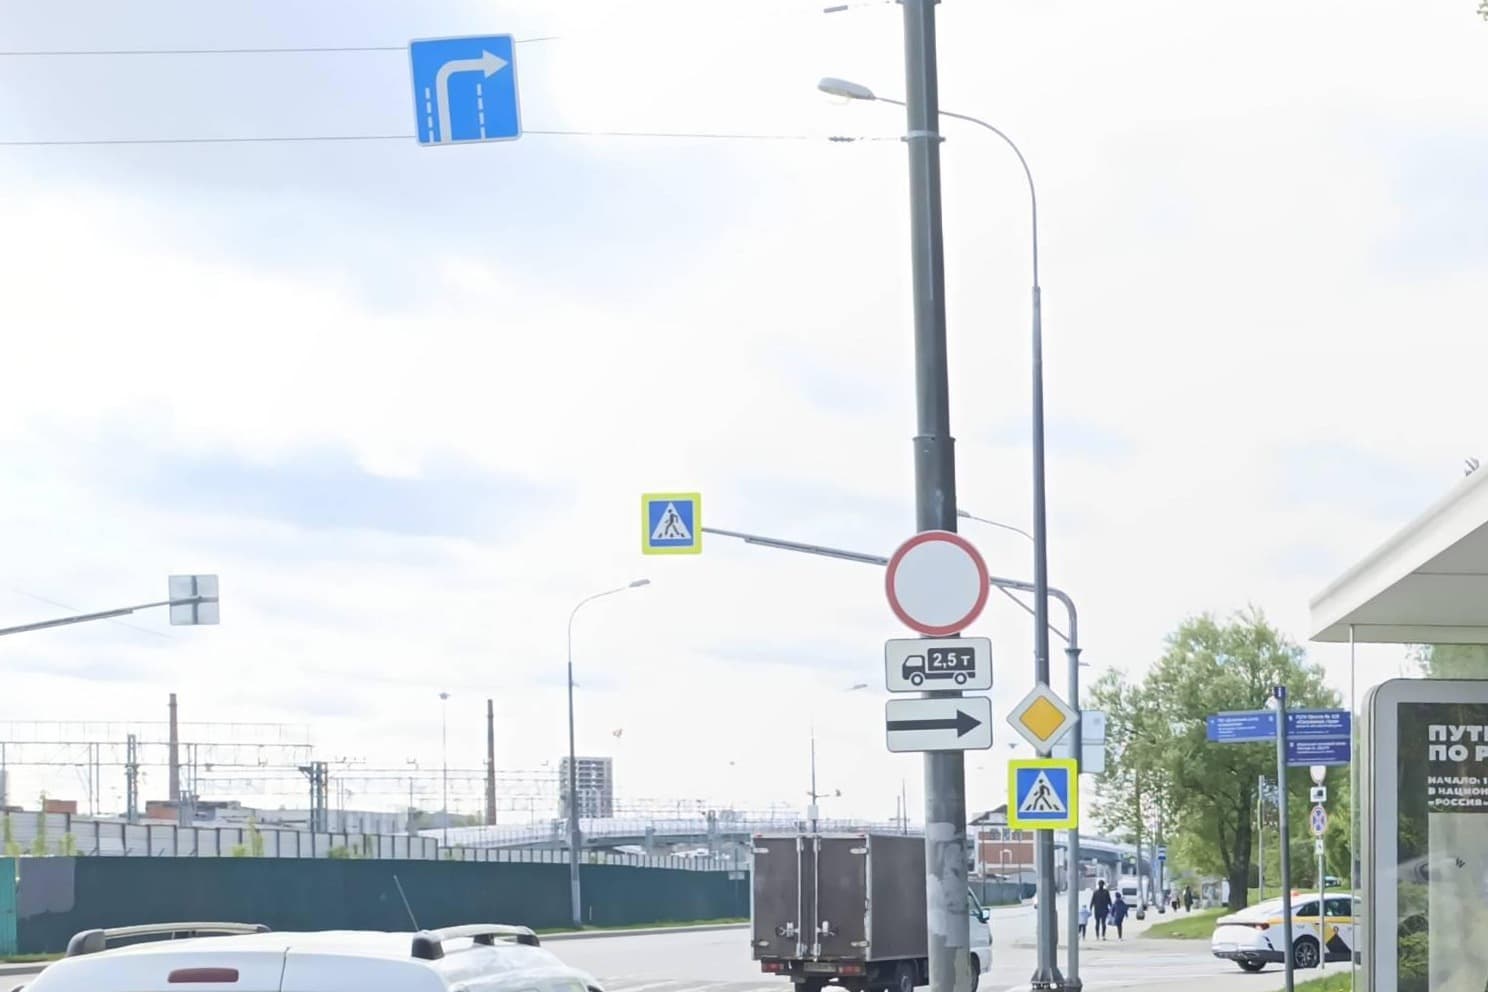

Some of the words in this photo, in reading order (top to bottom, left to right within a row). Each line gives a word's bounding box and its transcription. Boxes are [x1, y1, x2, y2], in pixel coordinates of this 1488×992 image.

[932, 652, 958, 669] 2,5
[1428, 745, 1469, 761] ПО
[1428, 776, 1481, 786] НАЧАЛО:
[1482, 777, 1488, 786] 1
